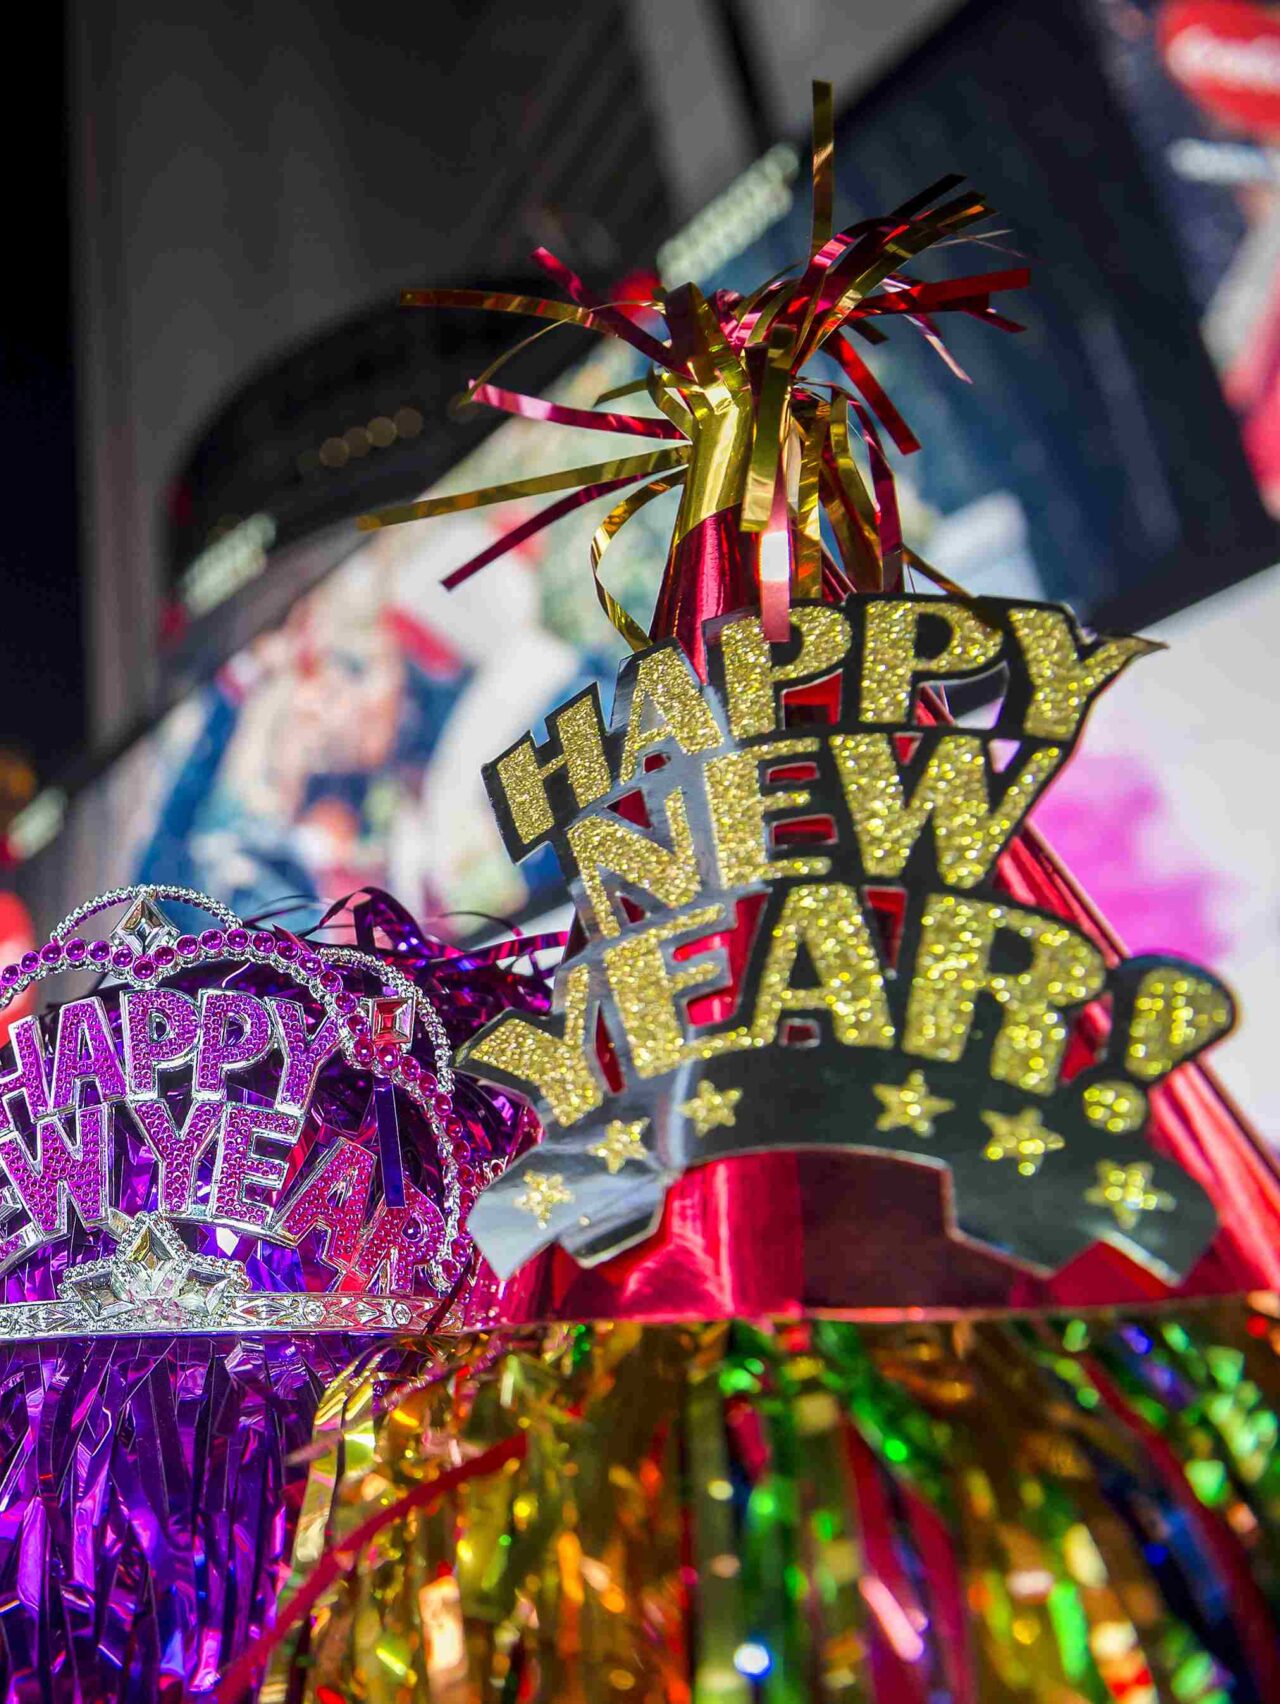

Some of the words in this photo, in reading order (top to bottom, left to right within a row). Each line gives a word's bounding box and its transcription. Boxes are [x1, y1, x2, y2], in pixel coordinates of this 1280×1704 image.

[496, 598, 1164, 848] HAPPY
[566, 732, 1062, 938] NEW
[468, 882, 1234, 1130] YEAR!
[128, 1098, 448, 1296] YEAR
